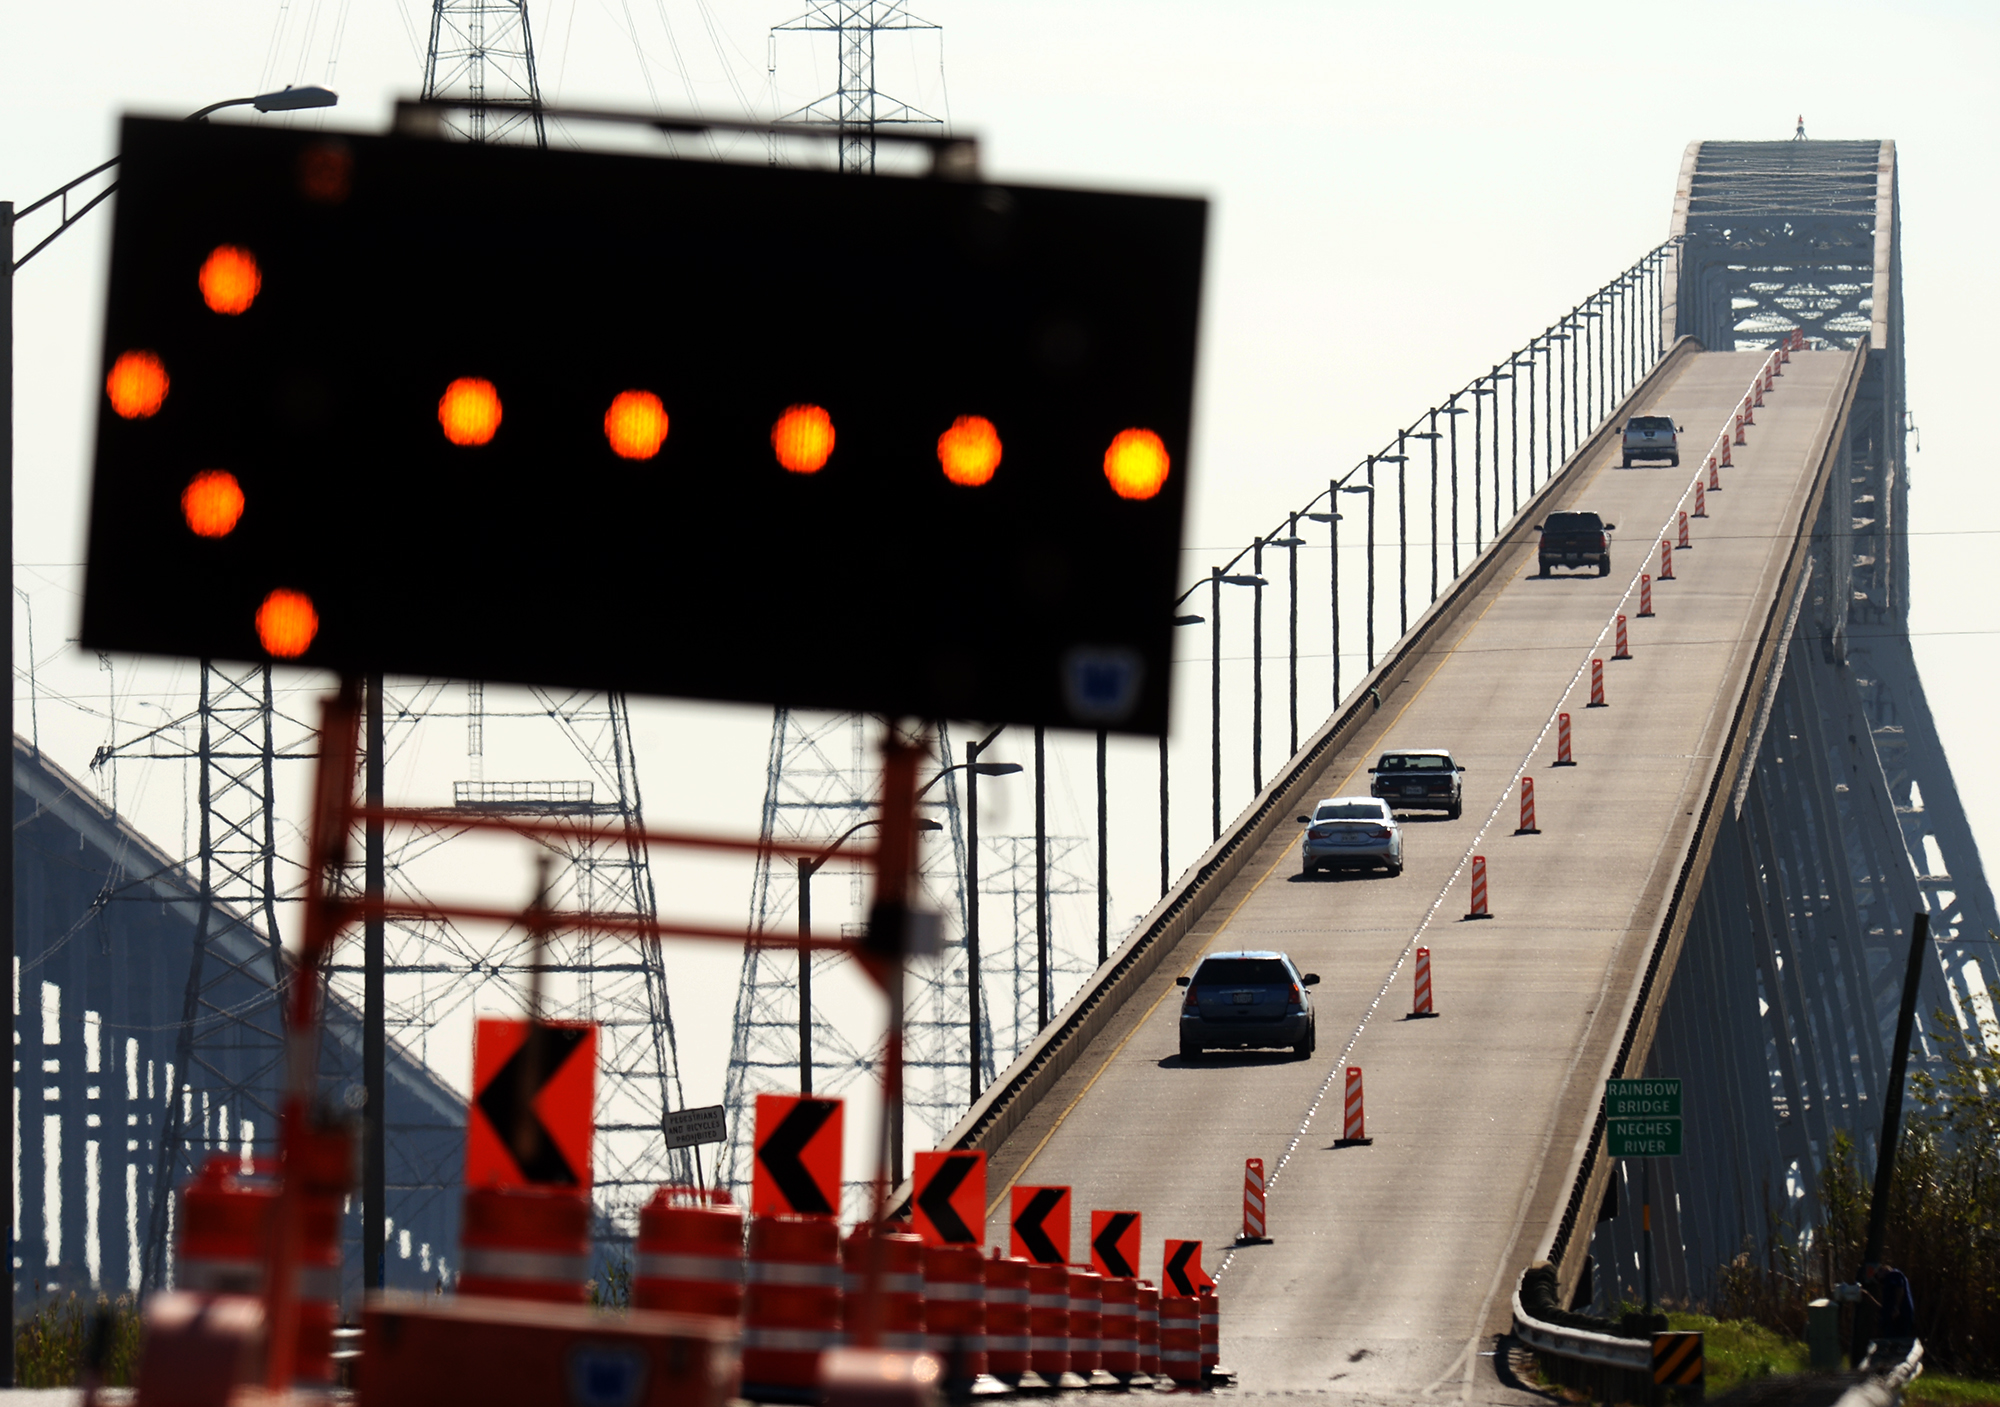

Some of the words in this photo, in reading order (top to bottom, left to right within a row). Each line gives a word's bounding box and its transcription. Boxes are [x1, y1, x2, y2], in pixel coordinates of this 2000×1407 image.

[1608, 1083, 1678, 1096] RAINBOW
[1617, 1100, 1670, 1113] BRIDGE
[670, 1111, 718, 1124] PEDESTRIANS
[669, 1126, 684, 1134] AND
[687, 1120, 720, 1132] BICYCLES
[1617, 1123, 1672, 1135] NECHES
[676, 1131, 717, 1142] PROHIBITED
[1624, 1140, 1666, 1152] RIVER
